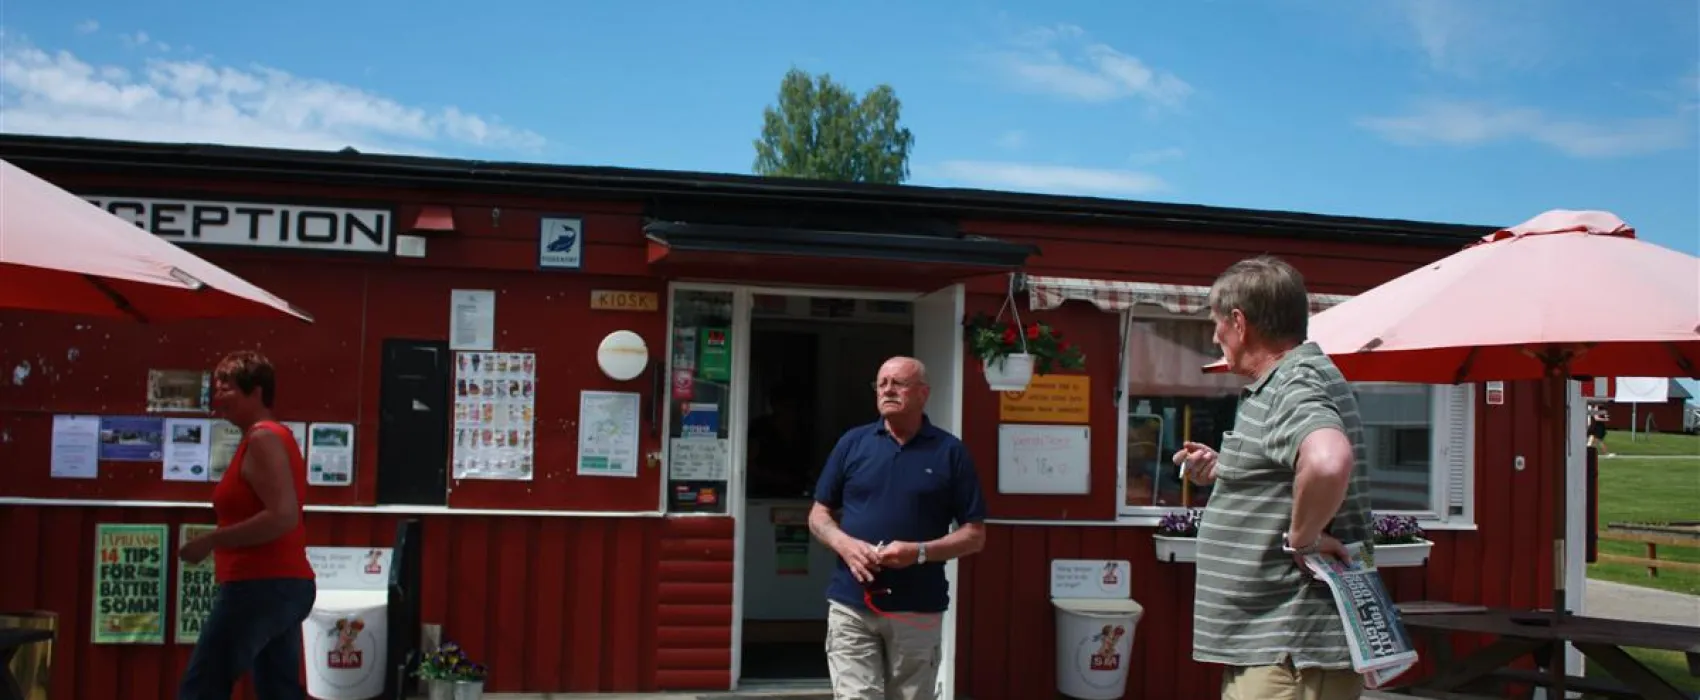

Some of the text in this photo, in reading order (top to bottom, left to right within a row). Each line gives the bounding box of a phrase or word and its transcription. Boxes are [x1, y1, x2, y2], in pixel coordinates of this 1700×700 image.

[92, 200, 384, 246] CEPTION
[600, 293, 649, 308] KIOSK
[101, 547, 159, 563] 14 TIPS
[183, 570, 215, 584] BER
[100, 597, 159, 614] SÖMN
